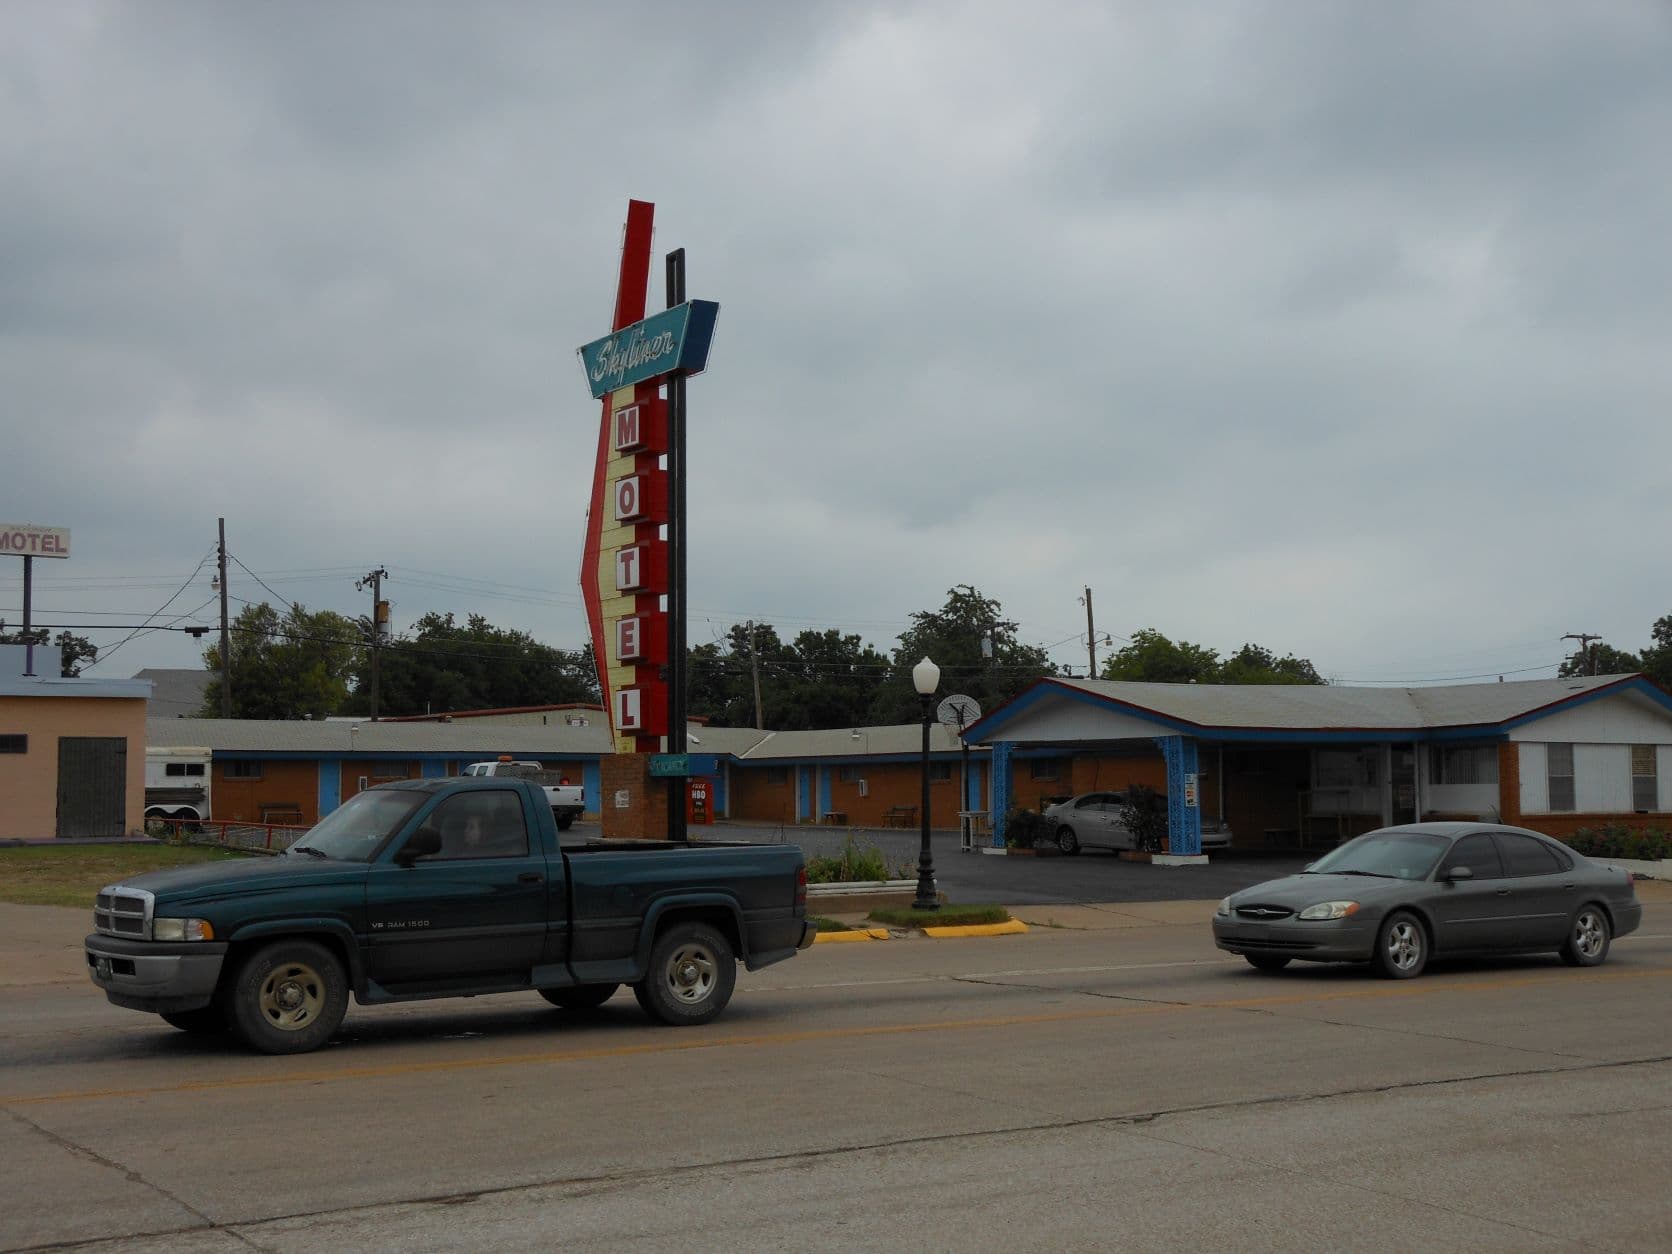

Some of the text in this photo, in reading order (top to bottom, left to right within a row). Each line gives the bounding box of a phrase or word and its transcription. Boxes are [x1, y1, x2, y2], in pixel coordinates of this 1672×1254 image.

[590, 324, 675, 385] Skyliner
[617, 407, 638, 727] MOTEL
[691, 790, 706, 800] HBO
